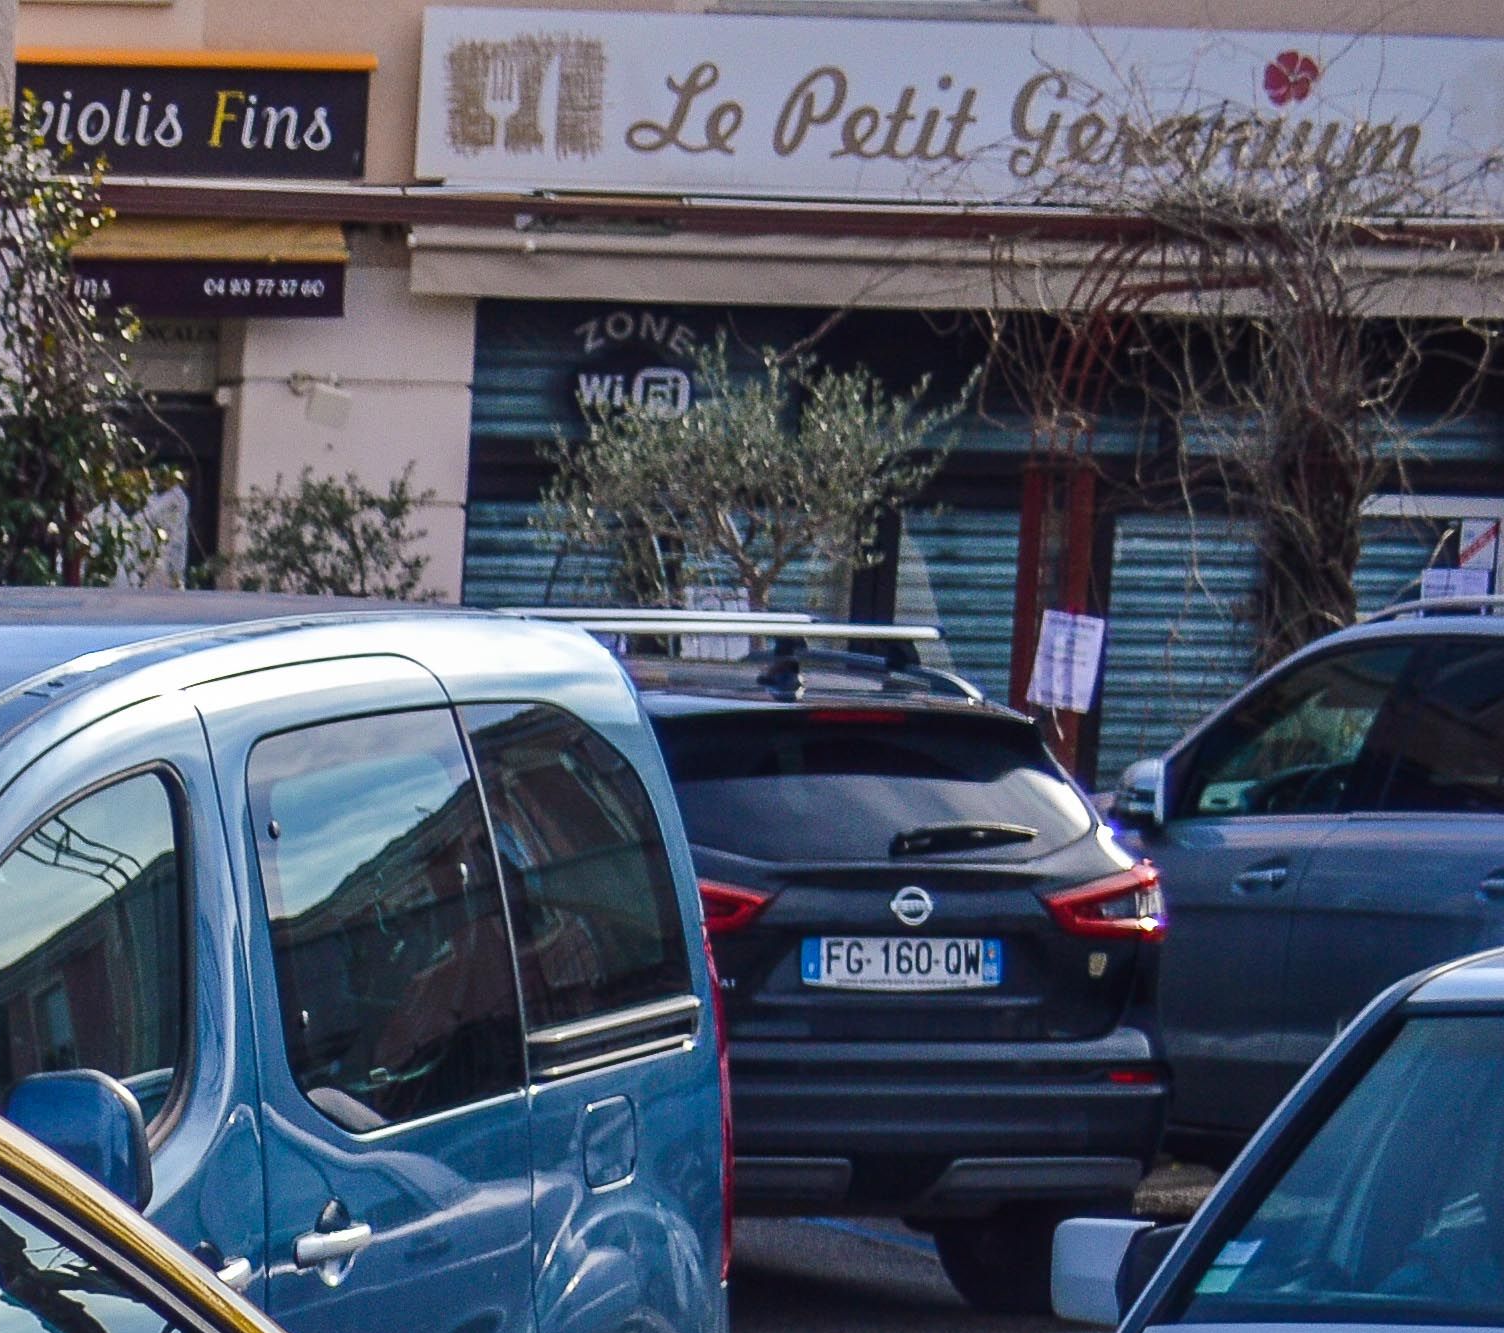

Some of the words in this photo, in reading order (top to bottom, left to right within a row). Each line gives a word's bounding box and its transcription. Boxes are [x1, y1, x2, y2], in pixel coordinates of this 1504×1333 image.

[208, 89, 333, 152] Fins
[627, 61, 744, 156] Le
[772, 65, 978, 163] Petit
[573, 311, 697, 356] ZONE
[825, 940, 981, 975] FG-160-QW
